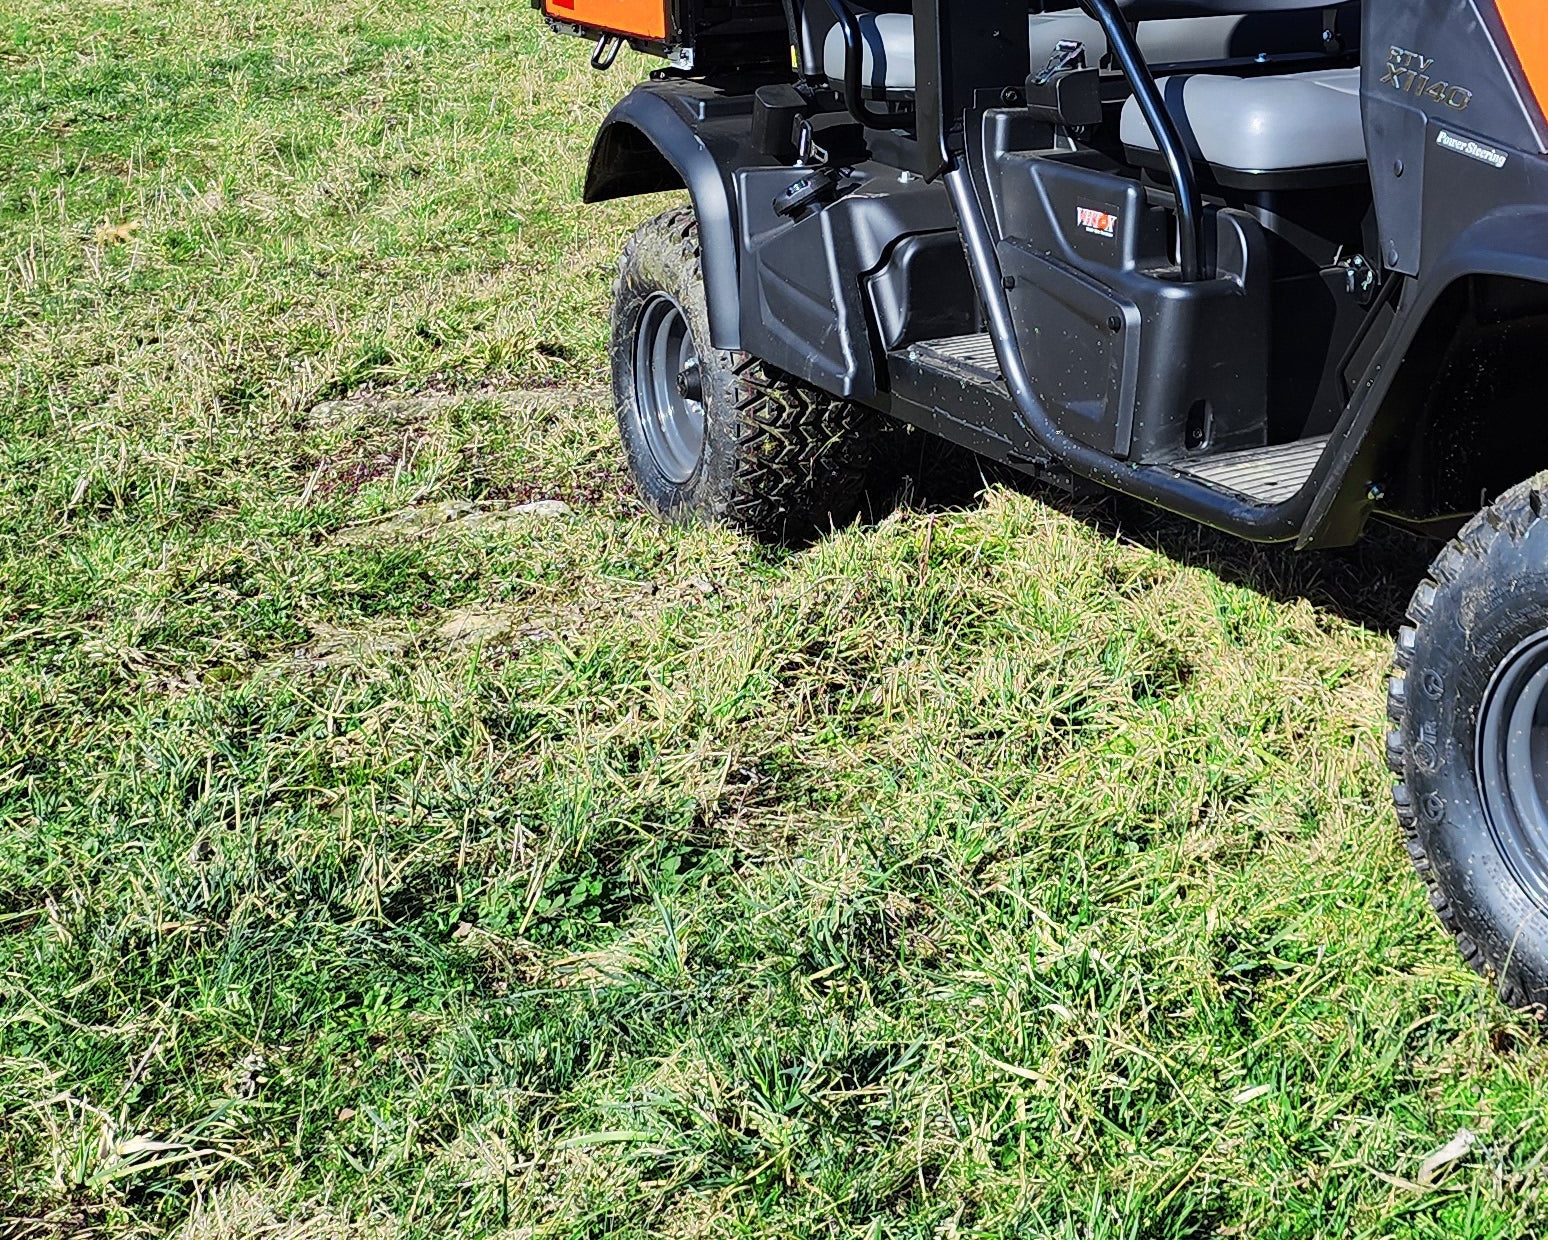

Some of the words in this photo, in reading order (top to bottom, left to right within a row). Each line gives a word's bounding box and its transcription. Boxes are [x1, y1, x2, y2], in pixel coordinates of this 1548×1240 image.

[1388, 45, 1434, 72] RTV
[1379, 62, 1472, 111] X1140
[1436, 130, 1467, 151] Power
[1465, 141, 1507, 168] Steering
